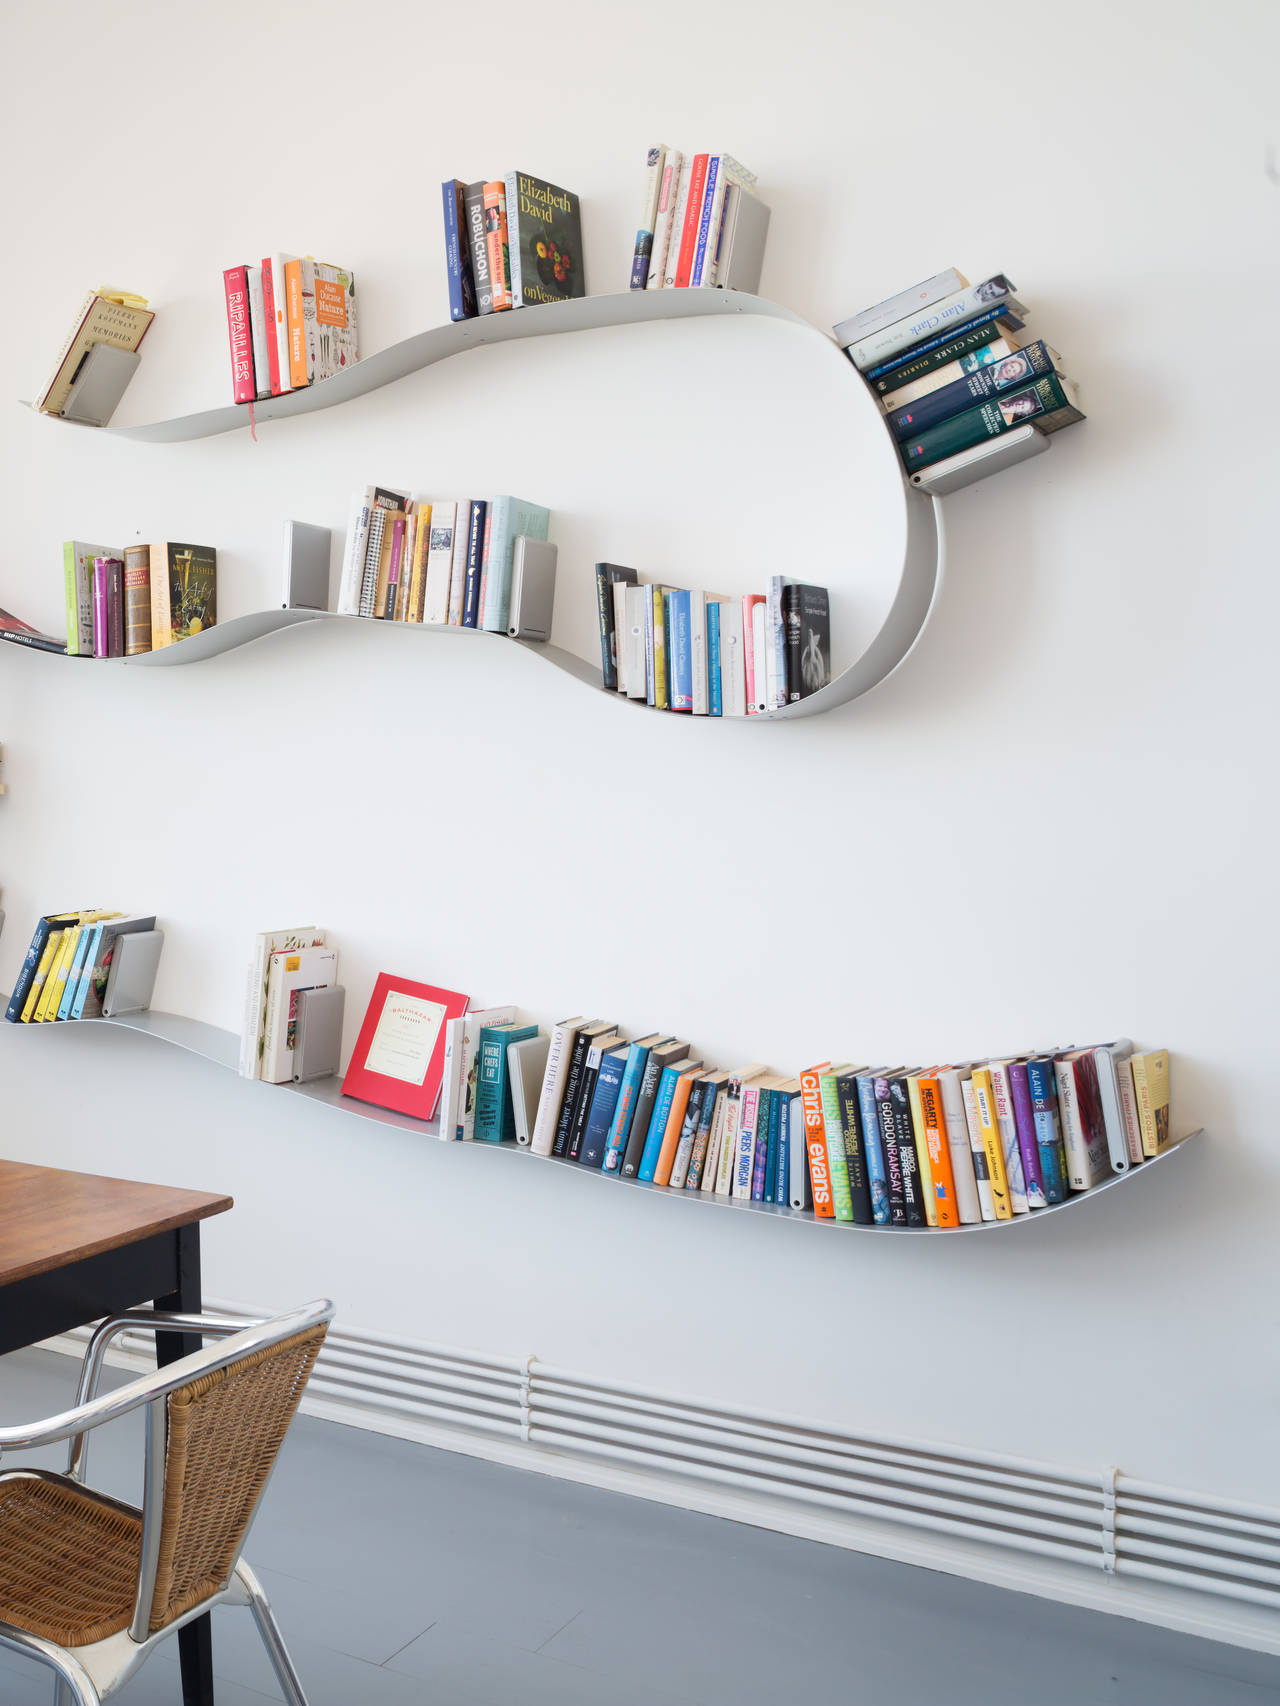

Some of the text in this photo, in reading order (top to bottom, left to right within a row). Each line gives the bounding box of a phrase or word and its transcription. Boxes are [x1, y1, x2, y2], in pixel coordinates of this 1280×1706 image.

[519, 176, 572, 213] Elizabeth
[521, 195, 553, 224] David
[470, 205, 489, 281] ROBUCHON
[909, 316, 940, 337] Clark
[940, 301, 967, 320] Alan
[229, 291, 250, 383] RIPAILLES
[897, 327, 991, 379] ALAN CLARK DIARIES
[544, 1031, 563, 1093] OVER HERE
[658, 1075, 676, 1134] ALAIN DE BOTTON
[801, 1075, 824, 1127] chris
[822, 1076, 841, 1120] CHRIS
[845, 1099, 856, 1126] WHITE
[925, 1088, 938, 1129] HEGARTY
[977, 1091, 987, 1112] START
[982, 1117, 990, 1126] UP
[993, 1071, 1009, 1116] Waiter Rant
[1031, 1069, 1050, 1146] ALAIN DE BOTTON
[737, 1130, 753, 1188] PIERS MORGAN
[881, 1102, 903, 1193] GORDON RAMSAY
[809, 1143, 830, 1204] evans
[831, 1161, 852, 1208] EVANS
[904, 1175, 915, 1204] WHITE
